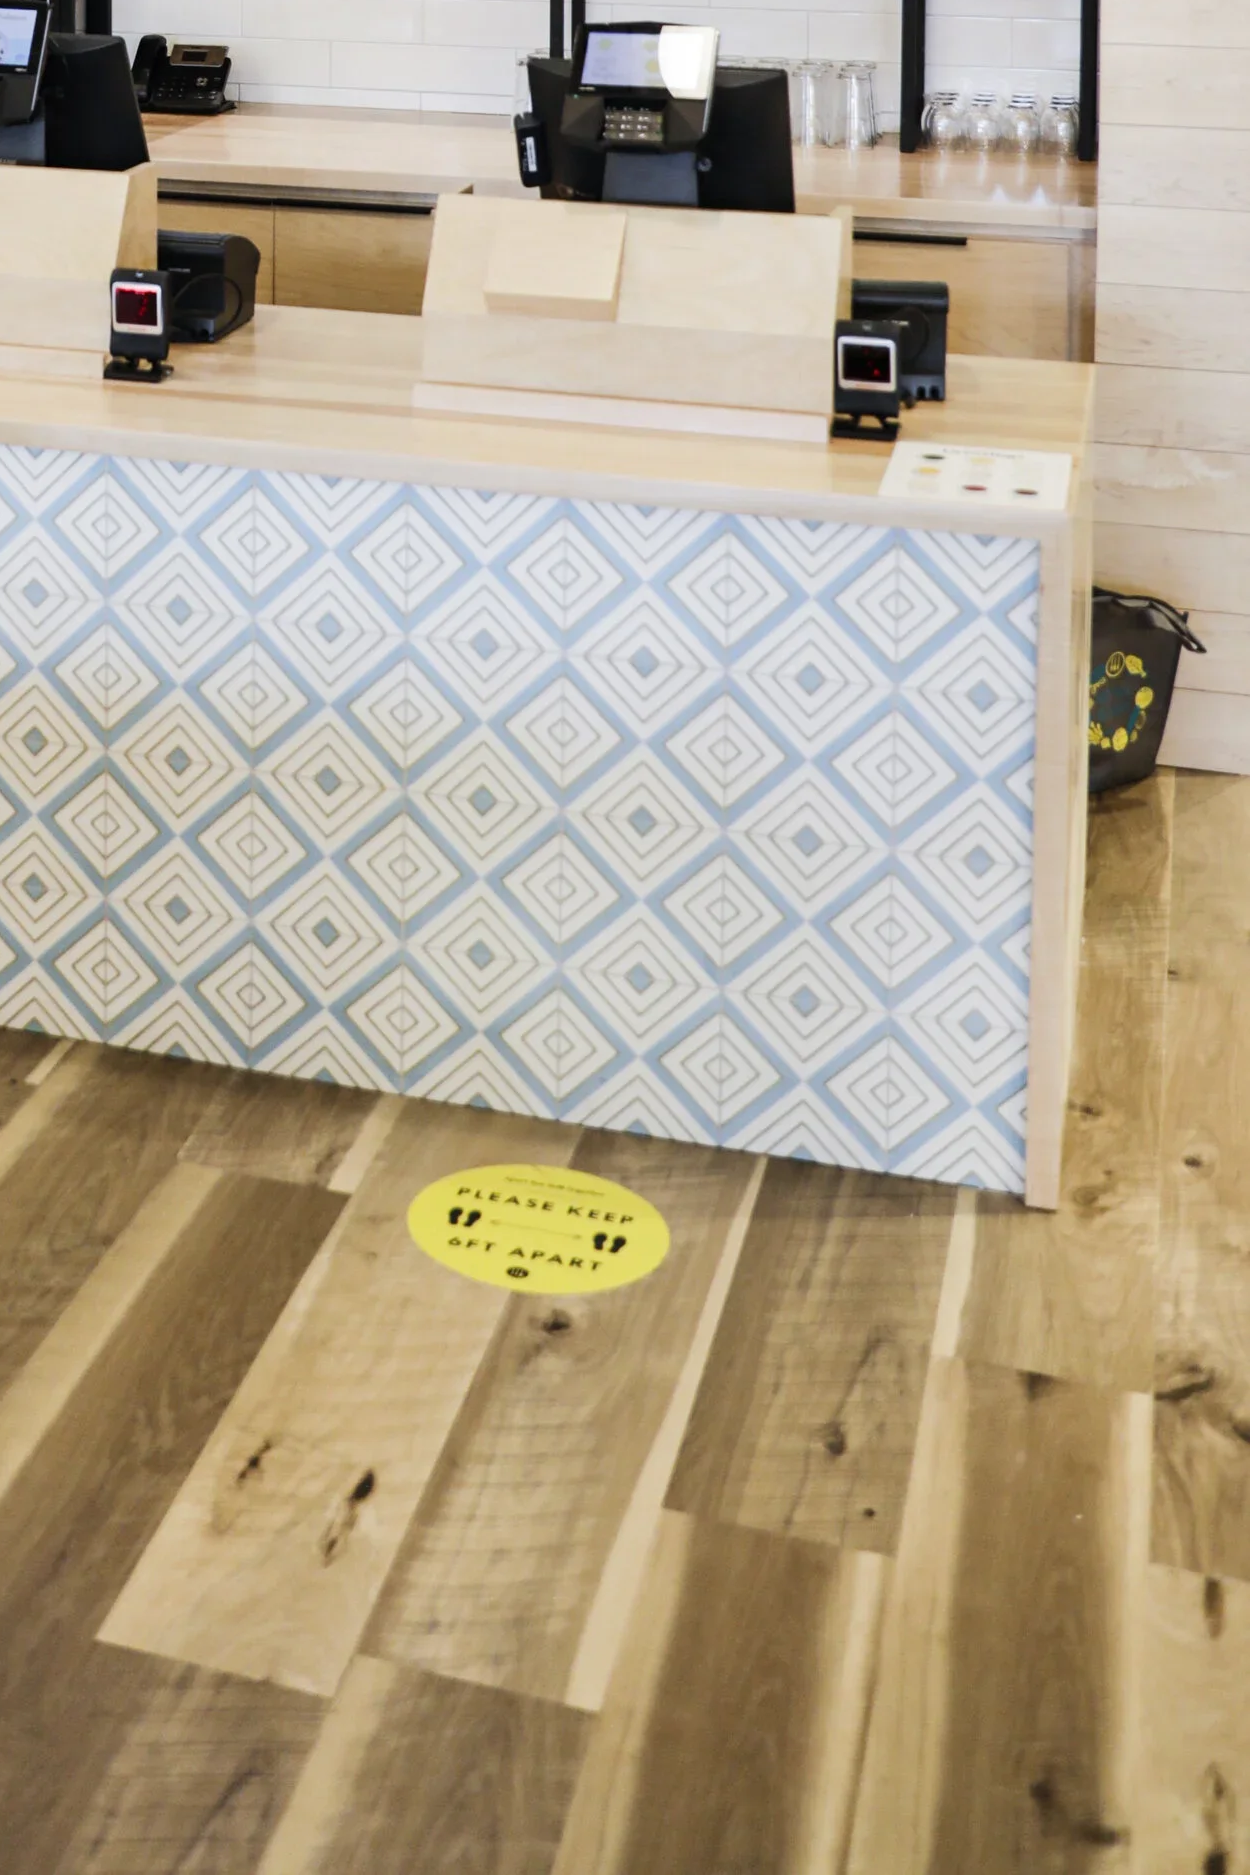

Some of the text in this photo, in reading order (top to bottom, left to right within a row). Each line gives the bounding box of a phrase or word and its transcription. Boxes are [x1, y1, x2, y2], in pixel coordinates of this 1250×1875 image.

[456, 1186, 555, 1212] PLEASE
[566, 1205, 635, 1224] KEEP
[447, 1236, 604, 1271] 6FT APART
